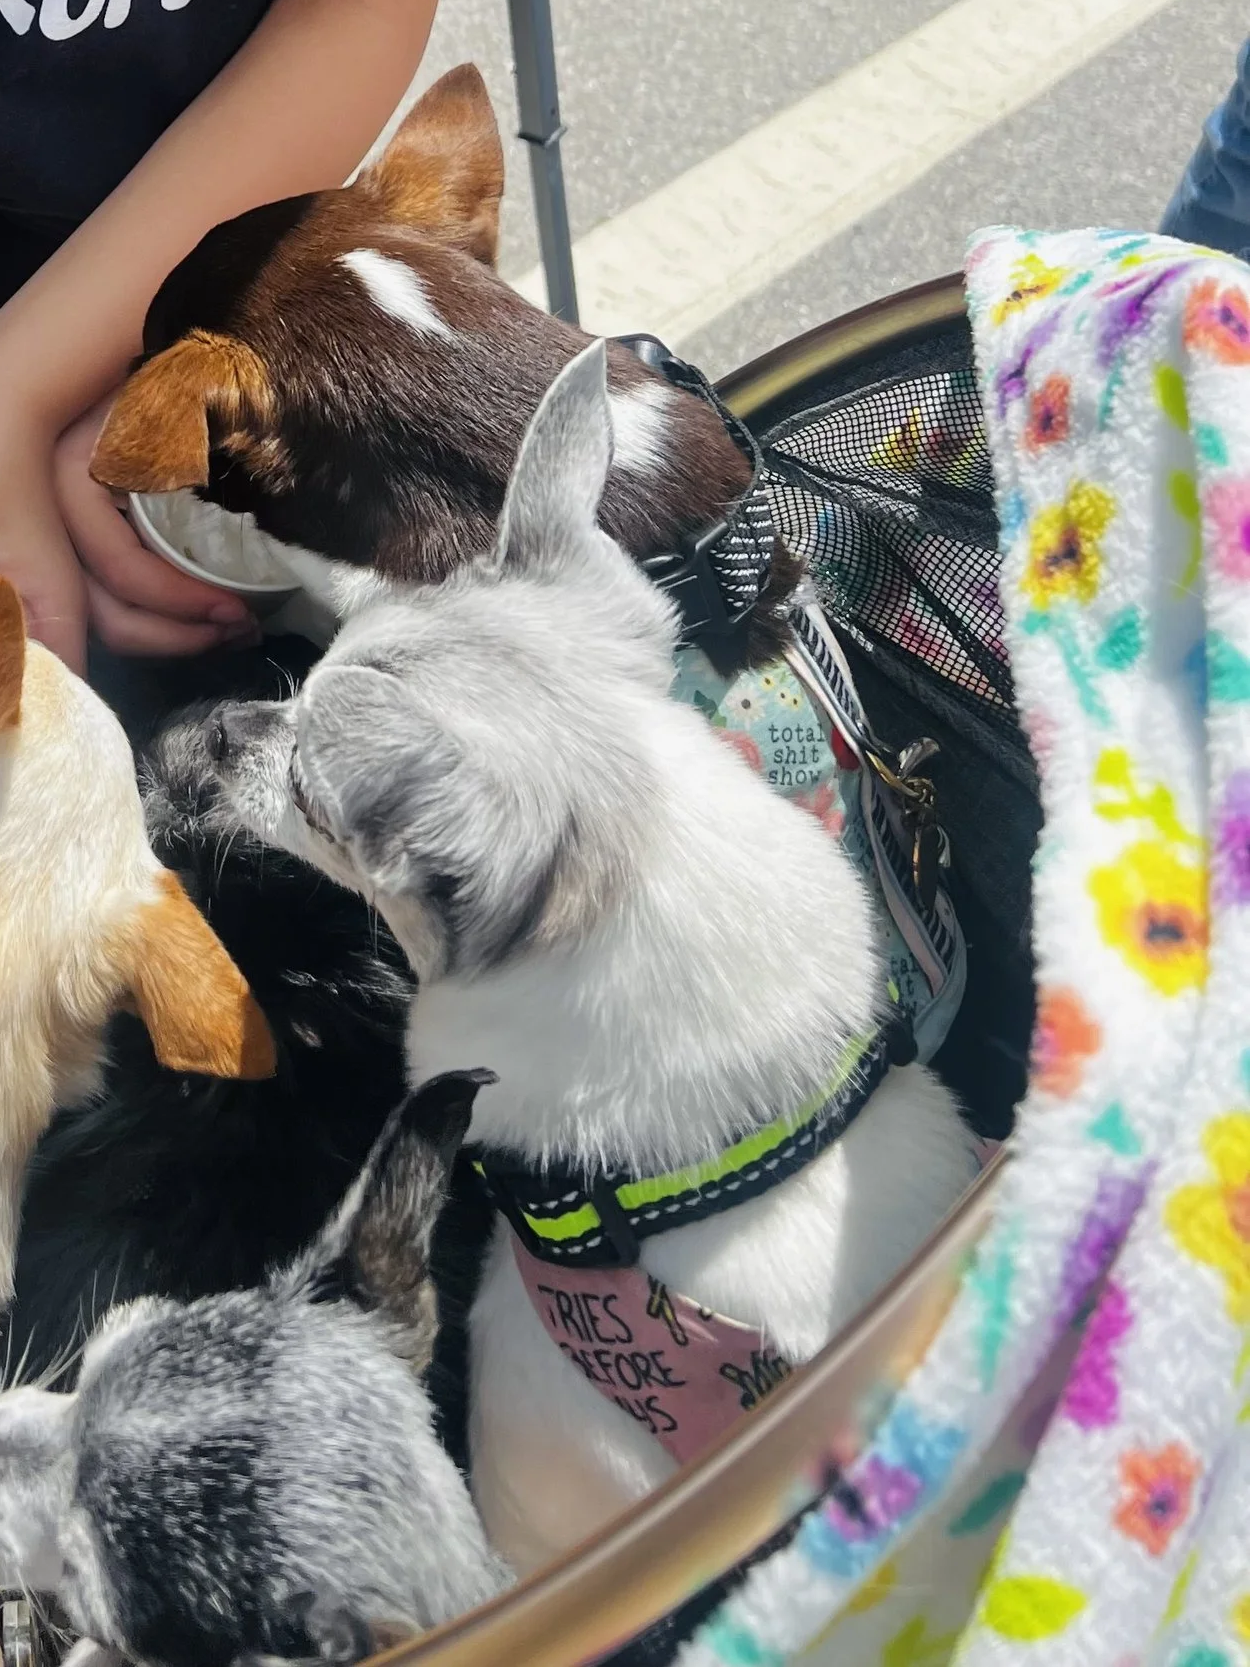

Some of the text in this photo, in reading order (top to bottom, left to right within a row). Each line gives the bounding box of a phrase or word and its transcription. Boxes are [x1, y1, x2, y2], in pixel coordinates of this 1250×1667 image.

[768, 724, 825, 743] total
[773, 745, 819, 765] shit
[768, 766, 822, 786] show
